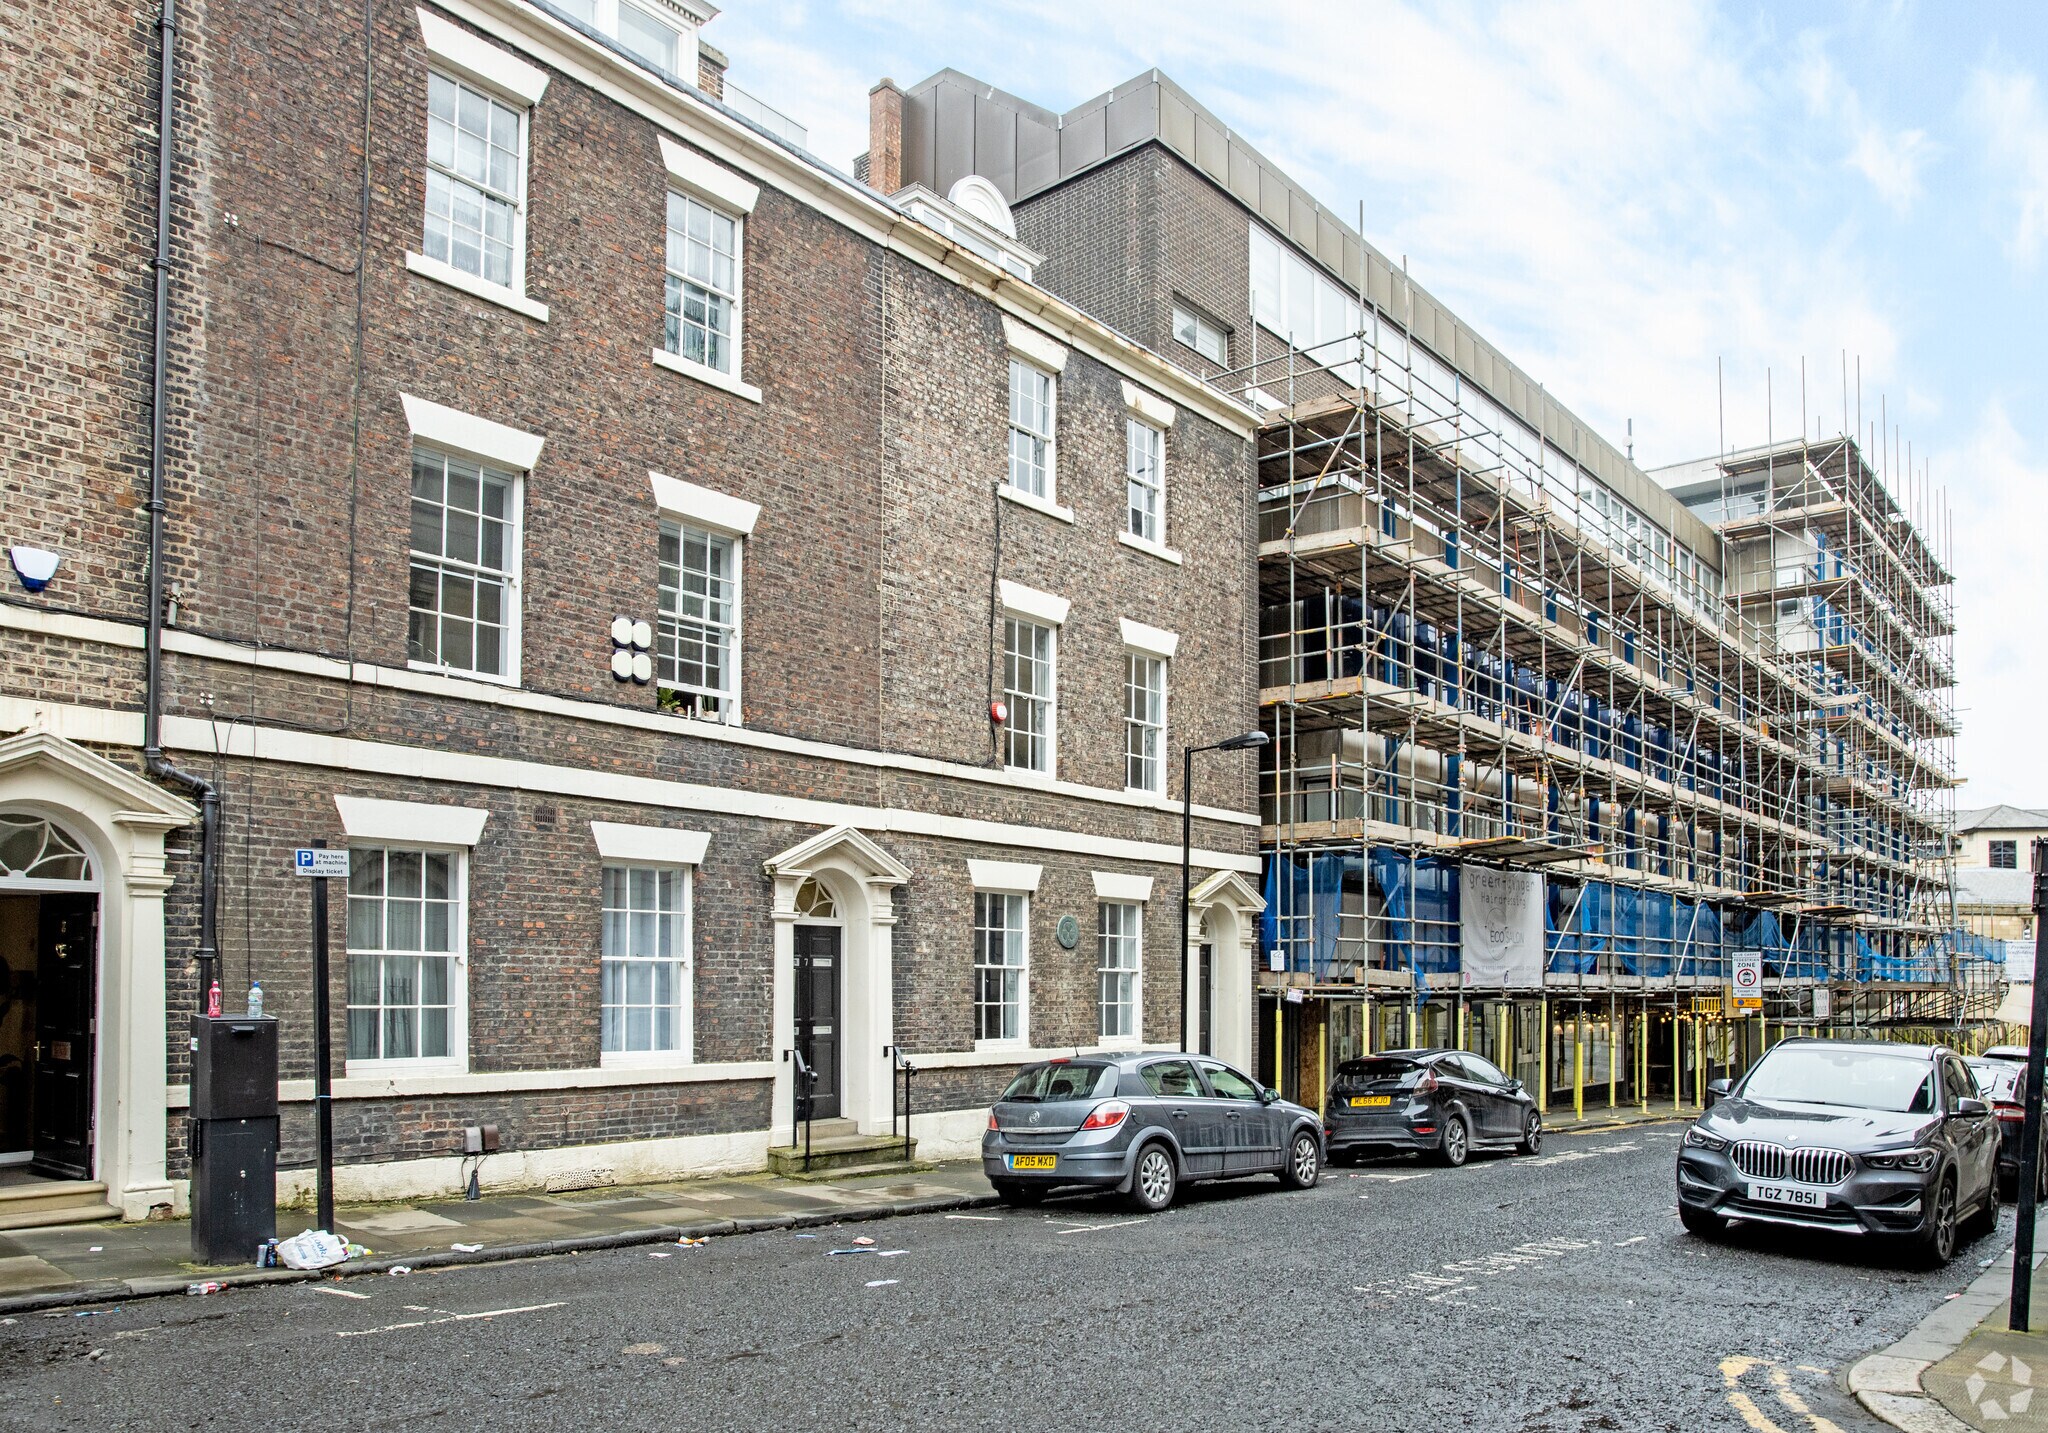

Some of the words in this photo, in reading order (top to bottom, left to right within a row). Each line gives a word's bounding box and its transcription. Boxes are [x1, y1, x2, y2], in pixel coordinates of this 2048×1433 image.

[300, 852, 312, 865] P
[803, 957, 809, 966] 7
[1015, 1156, 1036, 1166] AF05
[1037, 1156, 1054, 1166] MXD
[1756, 1186, 1782, 1200] TGZ
[1786, 1189, 1817, 1205] 7851
